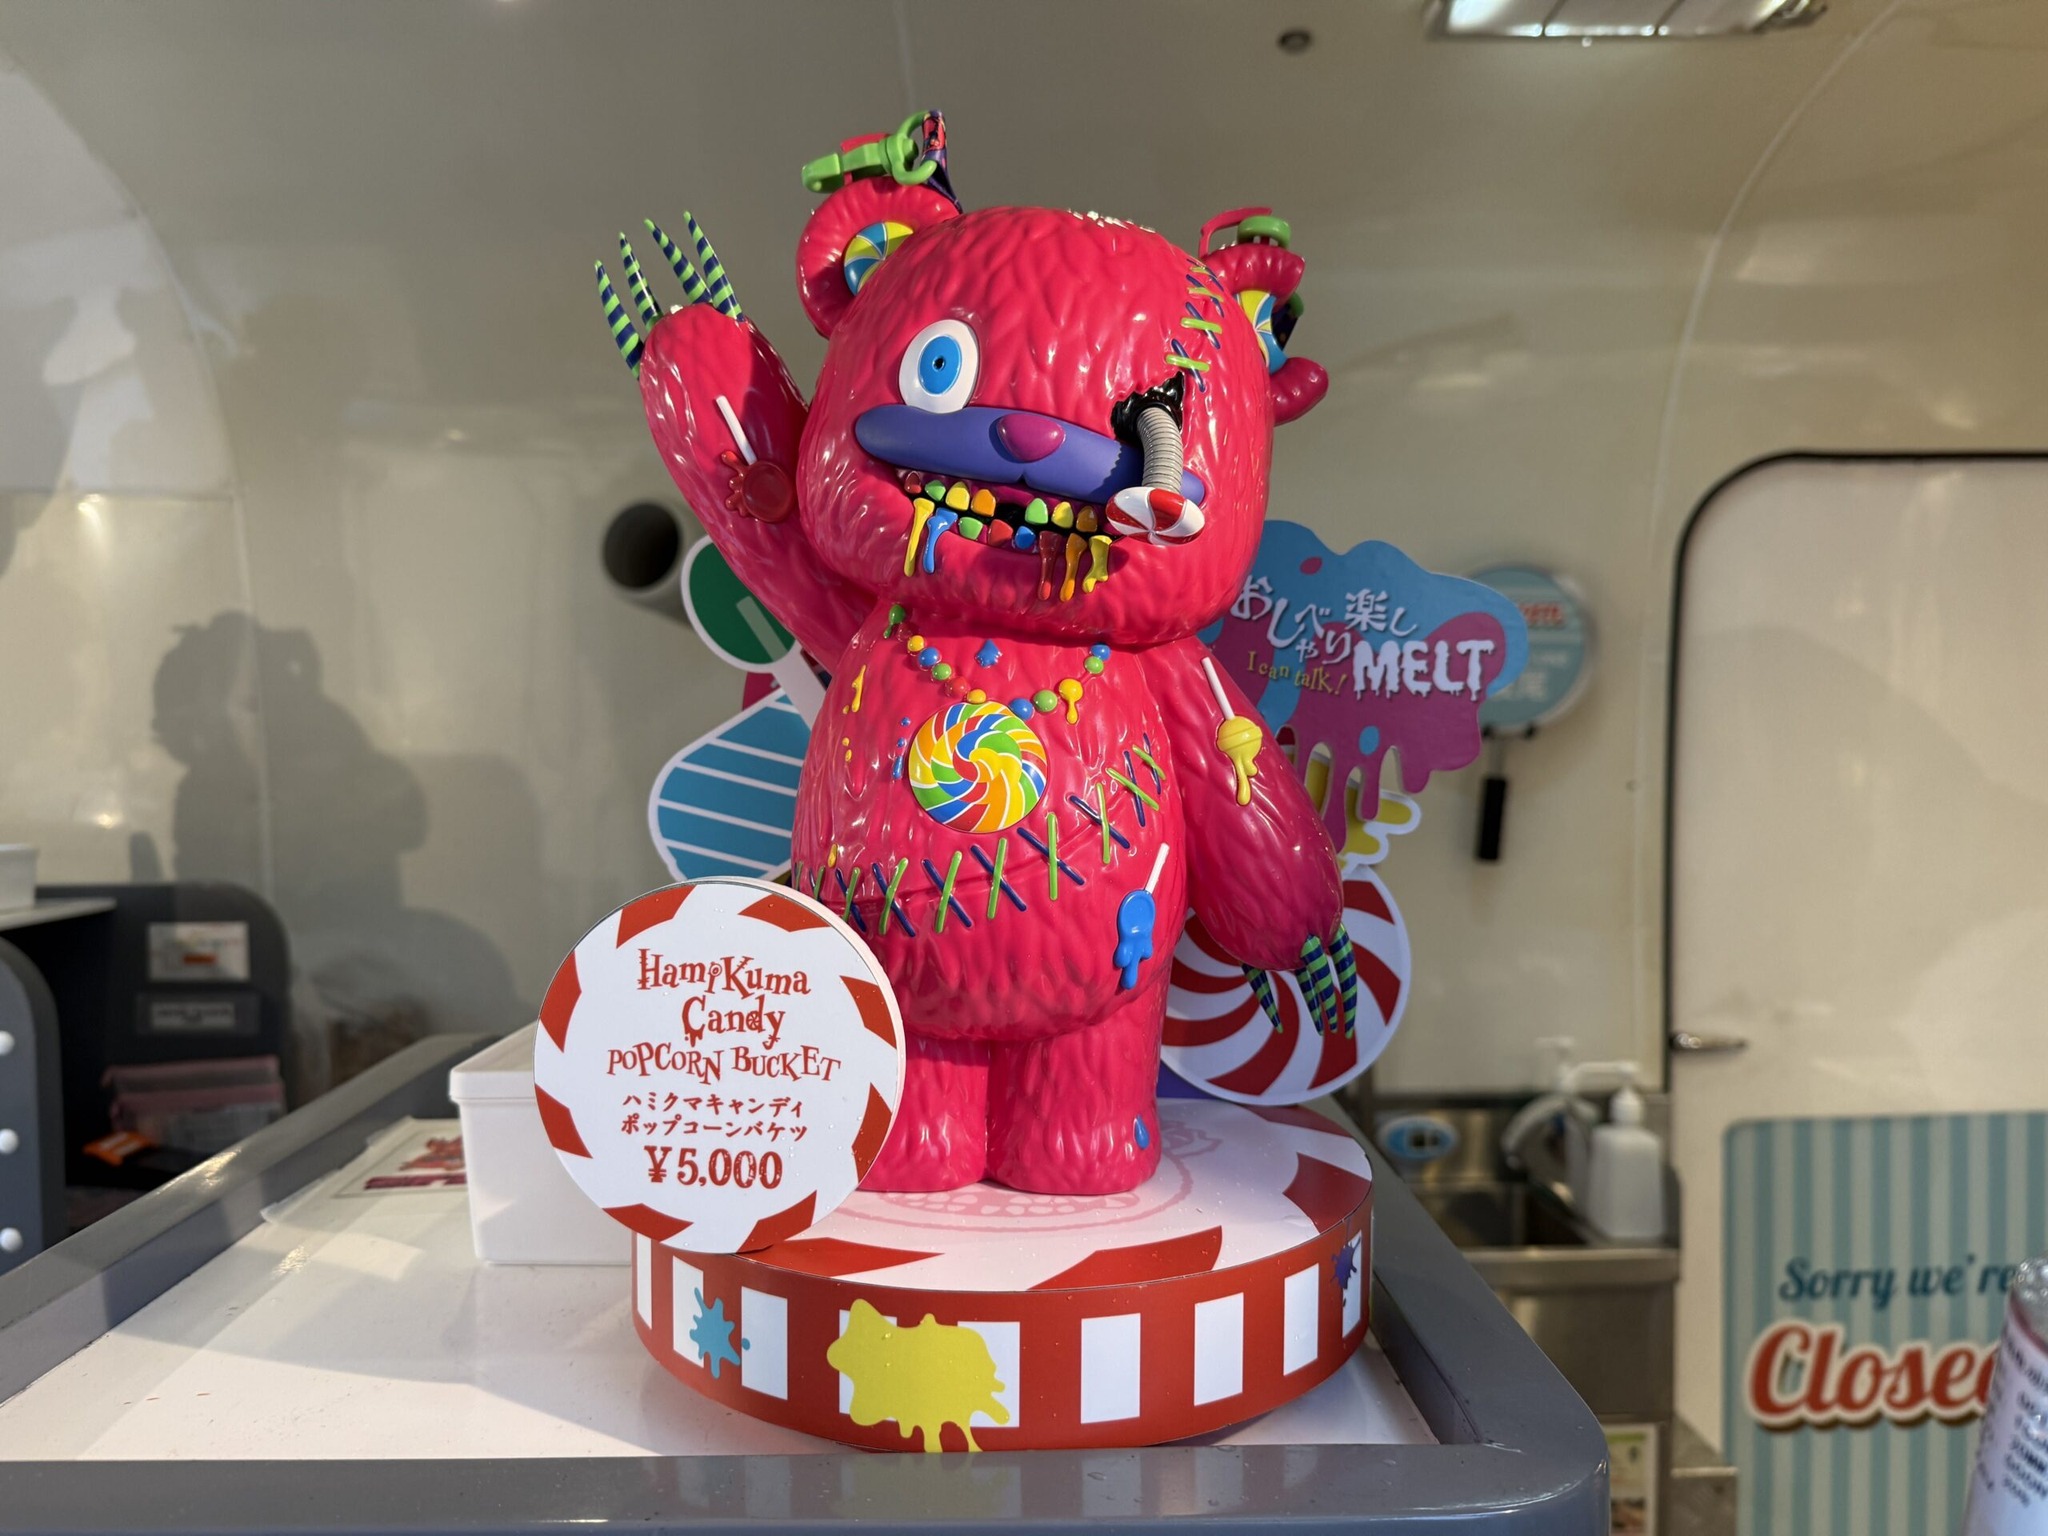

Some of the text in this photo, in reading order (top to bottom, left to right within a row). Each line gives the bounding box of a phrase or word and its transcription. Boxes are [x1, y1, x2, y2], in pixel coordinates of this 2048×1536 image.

[1247, 651, 1348, 695] I can talk!
[1353, 639, 1495, 700] MELT
[682, 995, 786, 1050] Candy
[731, 1045, 842, 1082] BUCKET
[622, 1092, 803, 1117] ハミクマキャンディ
[620, 1113, 808, 1142] ポップコーンバケツ
[644, 1145, 783, 1190] ¥5,000
[1779, 1257, 1897, 1312] Sorry
